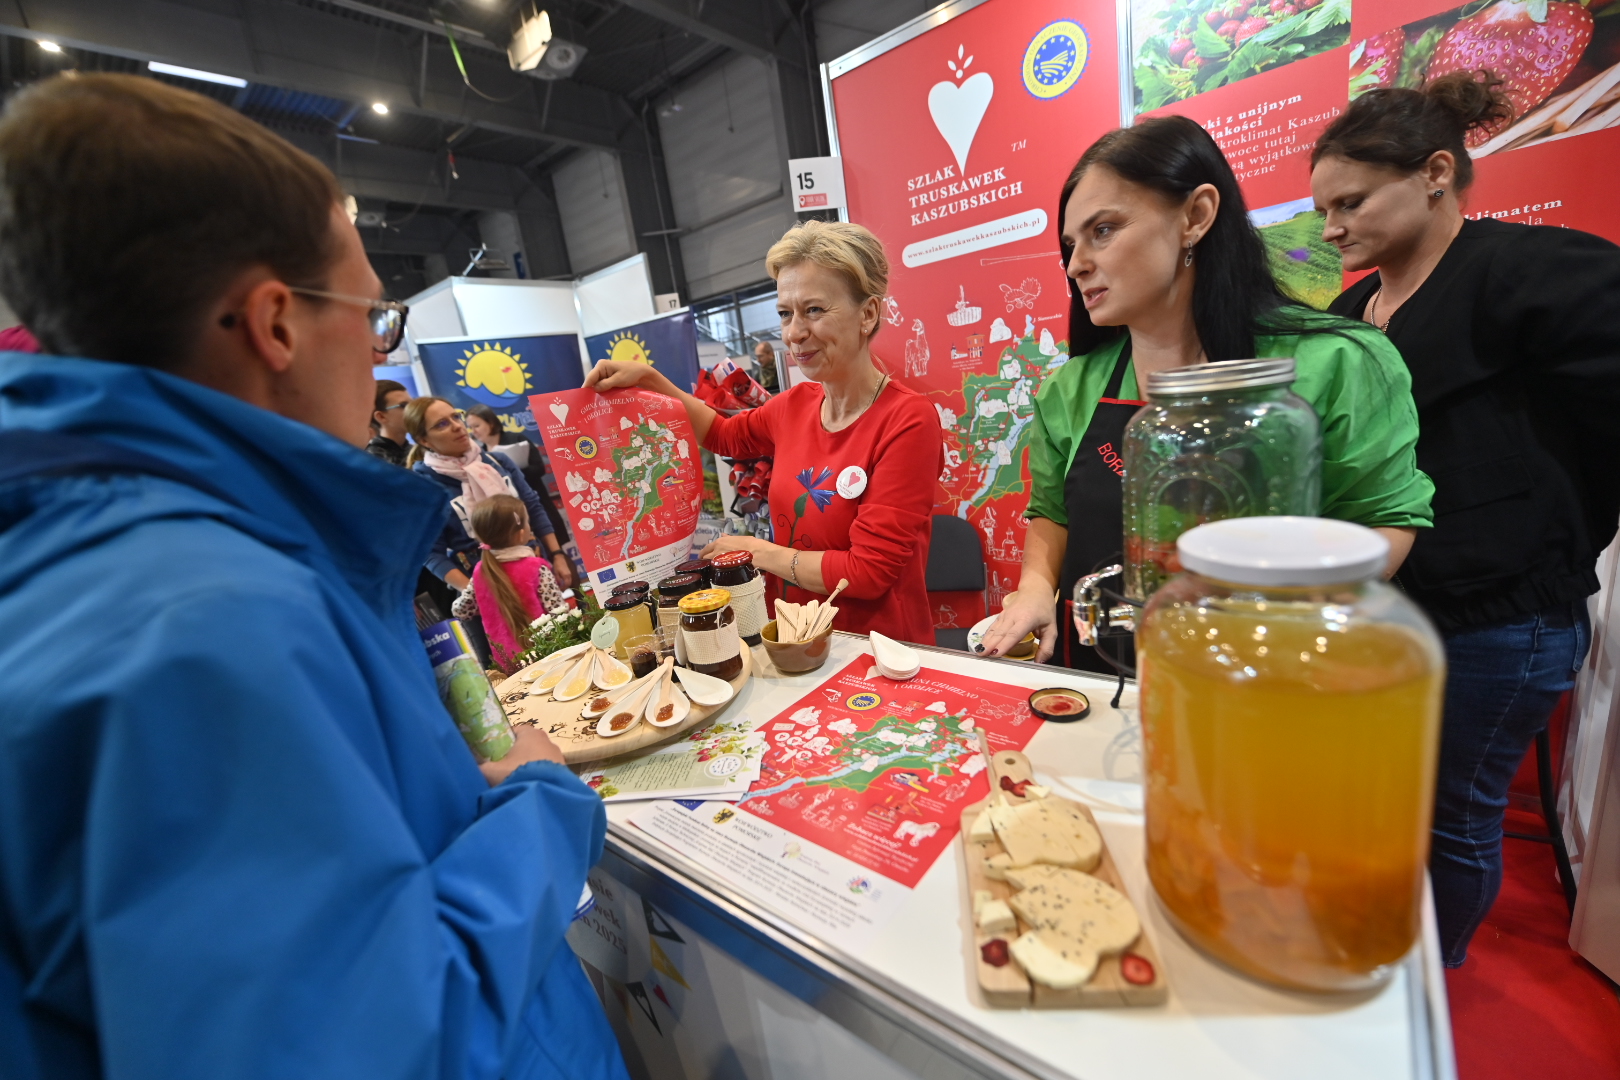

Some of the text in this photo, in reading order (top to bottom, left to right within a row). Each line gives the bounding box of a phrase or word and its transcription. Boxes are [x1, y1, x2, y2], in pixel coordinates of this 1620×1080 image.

[1226, 115, 1233, 124] z
[1238, 94, 1302, 120] unijnym
[1287, 106, 1341, 131] Kaszub
[1011, 138, 1028, 152] TM
[1264, 130, 1297, 150] tutaj
[907, 164, 956, 192] SZLAK
[1231, 160, 1245, 172] są
[797, 171, 815, 190] 15
[908, 166, 1007, 209] TRUSKAWEK
[910, 181, 1024, 227] KASZUBSKICH
[907, 217, 1041, 259] www.szlaktruskawekkaszubskich.pl
[669, 299, 677, 309] 17
[931, 681, 979, 699] CHMIELNO
[592, 918, 628, 956] 2025
